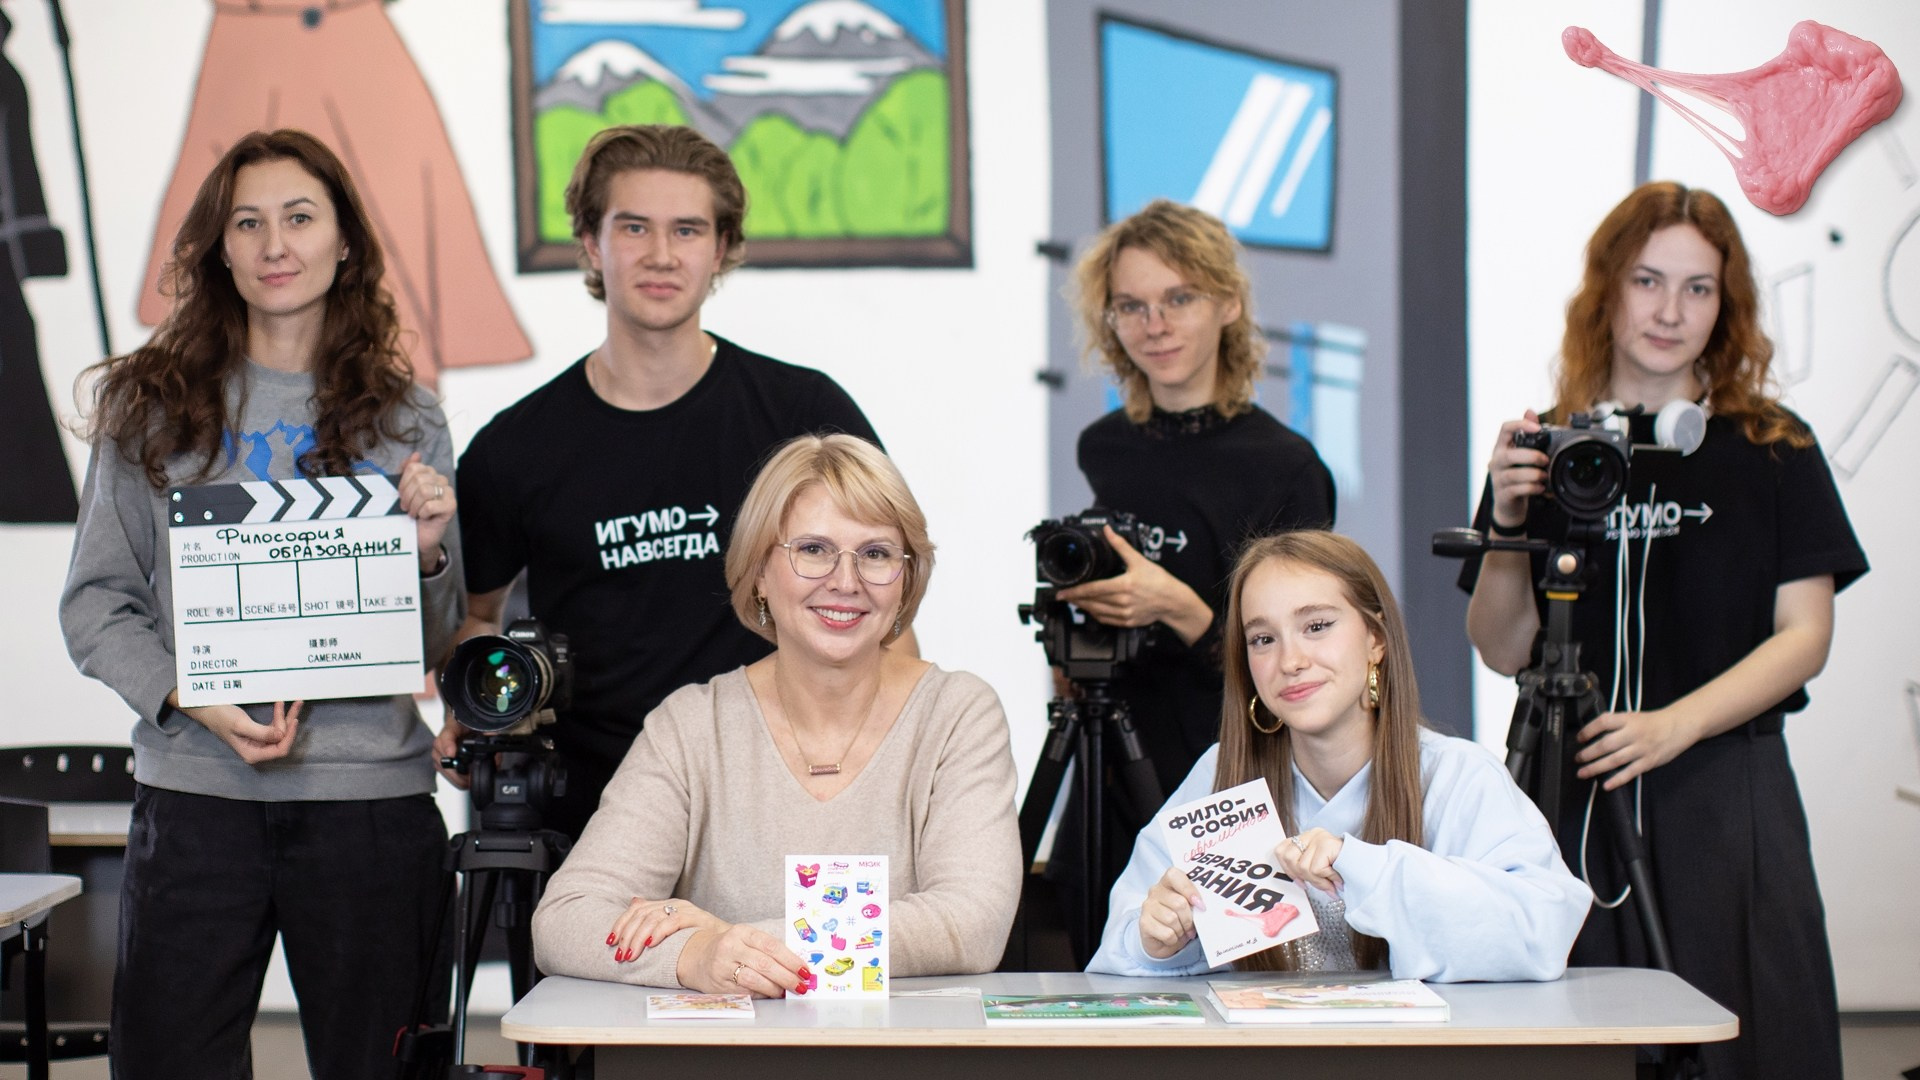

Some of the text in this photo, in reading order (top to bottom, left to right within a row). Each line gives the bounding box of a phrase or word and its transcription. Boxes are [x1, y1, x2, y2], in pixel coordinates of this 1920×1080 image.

[1603, 501, 1682, 529] ГУМО
[595, 506, 686, 545] ИГУМО
[216, 527, 344, 545] Философия
[269, 537, 401, 559] ОБРАЗОВАНИЯ
[600, 532, 719, 570] НАВСЕГДА
[181, 552, 241, 563] PRODUCTION
[245, 604, 276, 615] SCENE
[304, 601, 330, 611] SHOT
[364, 597, 387, 607] TAKE
[186, 607, 210, 617] ROLL
[192, 645, 211, 655] 导演
[308, 652, 361, 663] CAMERAMAN
[190, 659, 238, 670] DIRECTOR
[192, 679, 242, 691] DATE 日期
[1168, 798, 1245, 830] ФИЛО-
[1191, 803, 1269, 838] СОФИЯ
[1191, 853, 1294, 882] ОБРАЗО-
[1186, 866, 1284, 913] ВАНИЯ
